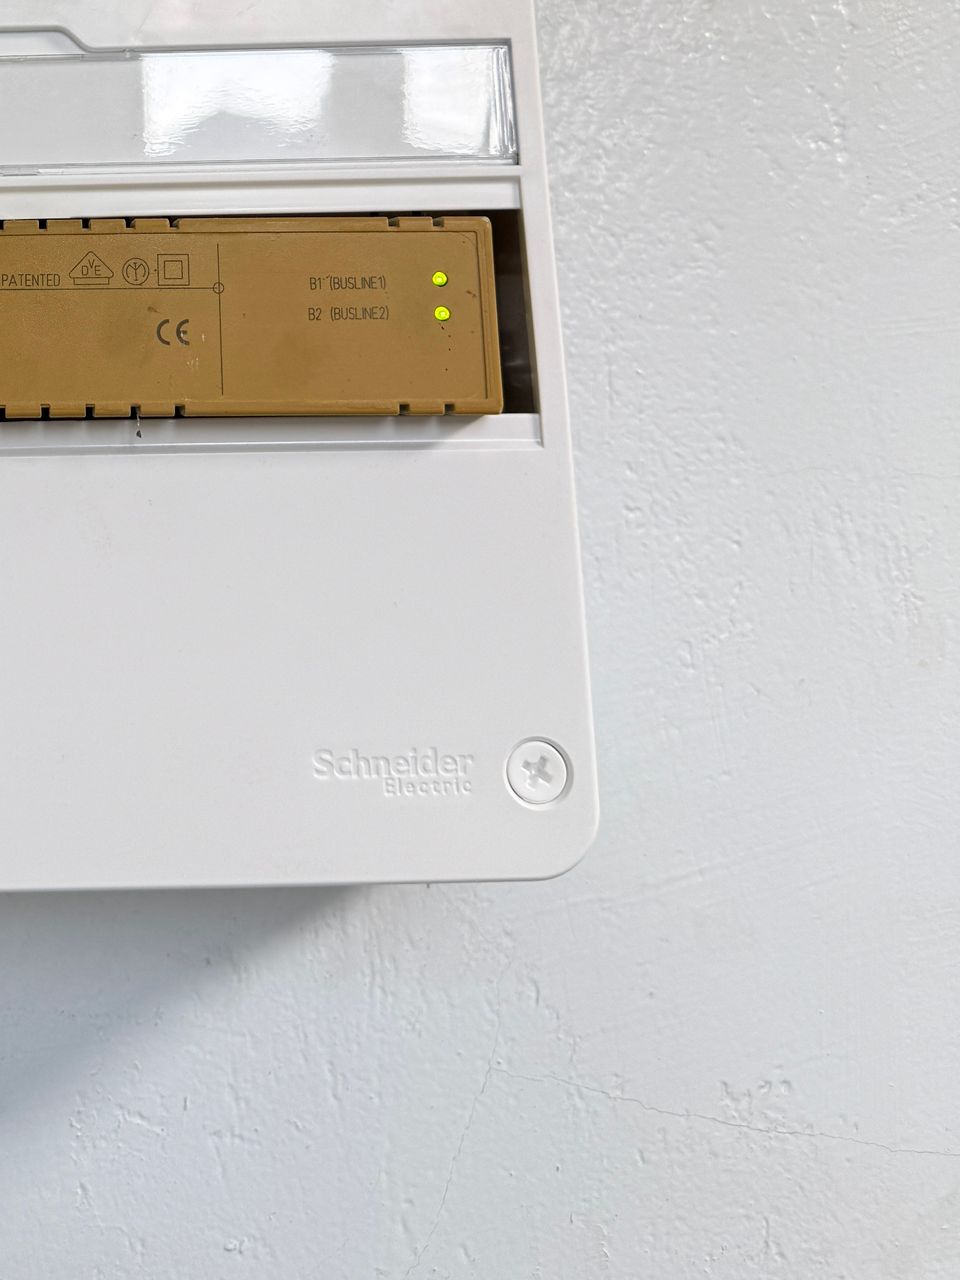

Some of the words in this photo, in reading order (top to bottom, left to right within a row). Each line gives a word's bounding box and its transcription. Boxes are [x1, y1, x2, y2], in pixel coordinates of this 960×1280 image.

[1, 273, 61, 287] PATENTED
[309, 277, 322, 290] B1
[330, 275, 386, 291] (BUSLINE1)
[308, 307, 322, 320] B2
[330, 305, 389, 322] (BUSLINE2)
[156, 319, 190, 346] CE
[311, 747, 475, 780] Schneider
[383, 777, 473, 796] Electric
